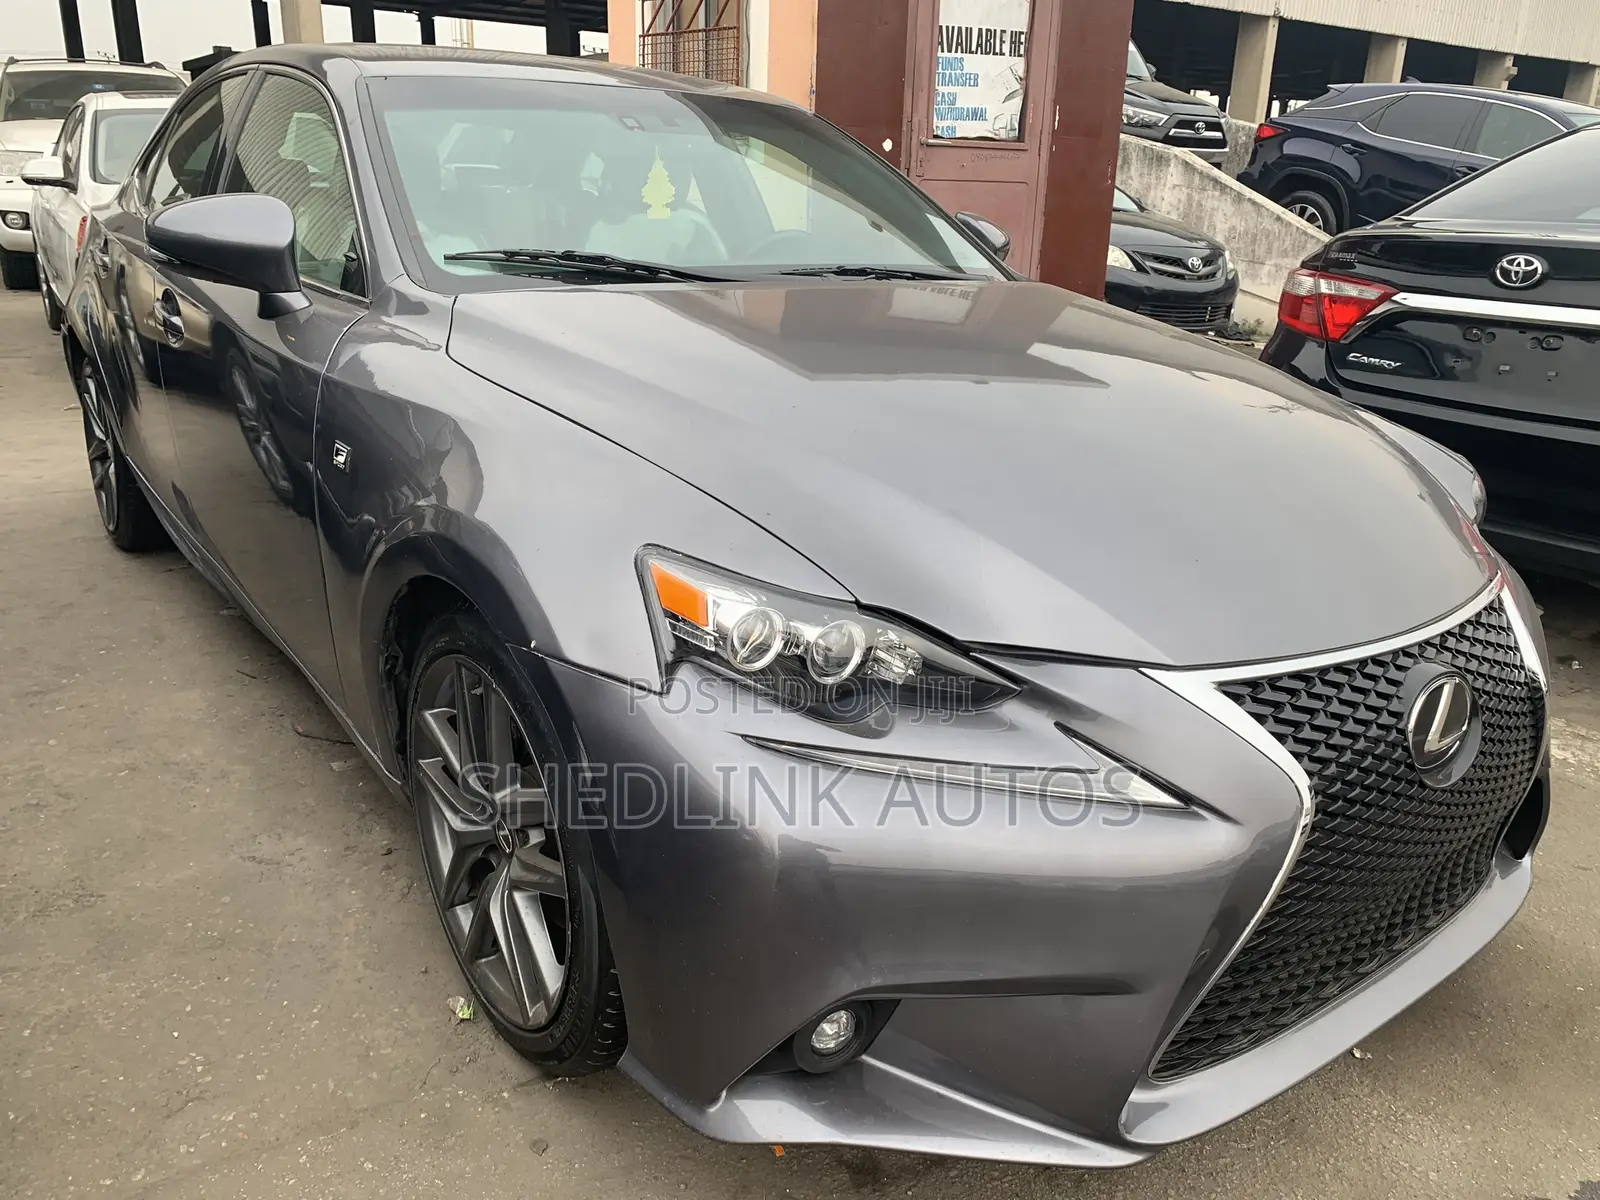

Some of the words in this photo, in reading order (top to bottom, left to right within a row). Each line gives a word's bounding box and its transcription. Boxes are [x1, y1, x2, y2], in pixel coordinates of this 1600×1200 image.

[938, 25, 1006, 56] AVAILABLE
[936, 56, 964, 71] FUNDS
[936, 72, 979, 87] TRANSFER
[935, 91, 957, 106] CASH
[935, 106, 988, 122] WITHDRAWAL
[1346, 353, 1401, 369] CAMRY
